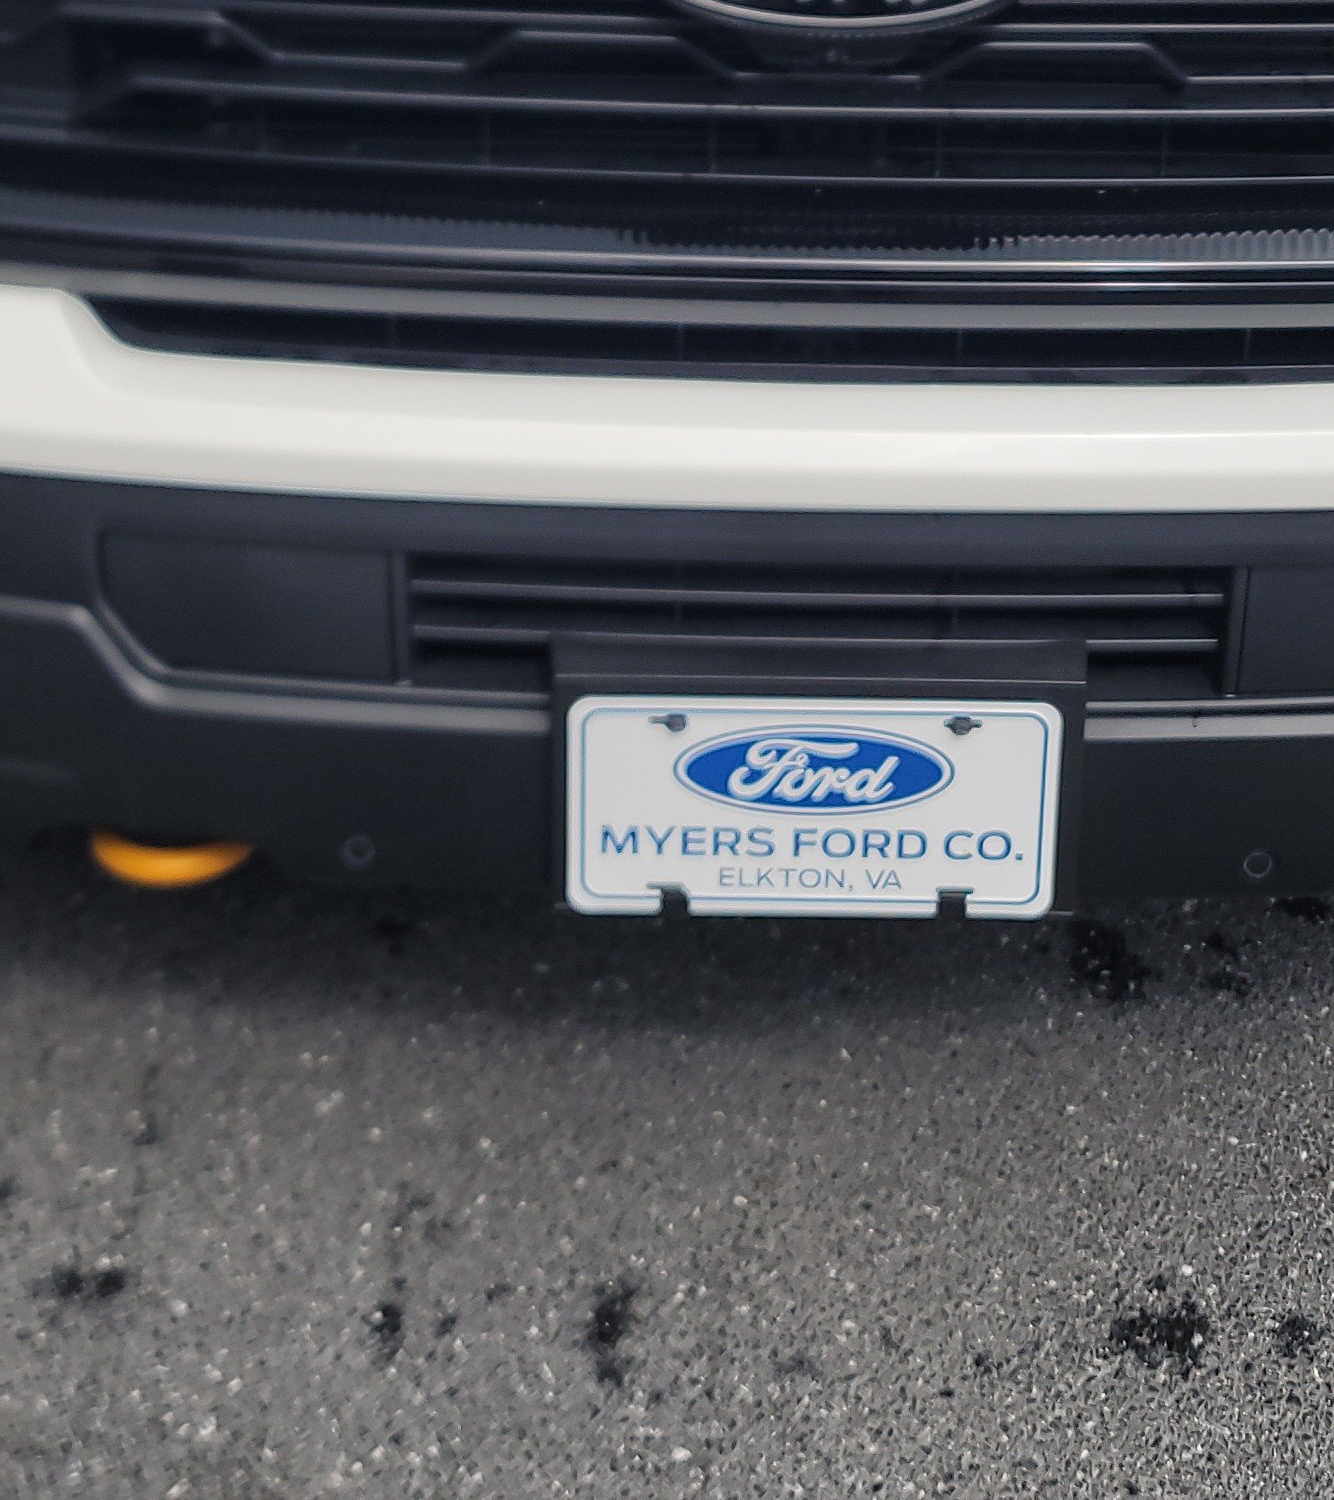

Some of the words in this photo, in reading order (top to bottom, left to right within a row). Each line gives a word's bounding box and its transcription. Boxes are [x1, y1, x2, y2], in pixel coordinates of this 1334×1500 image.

[727, 738, 899, 801] Ford
[600, 825, 775, 858] MYERS
[792, 828, 927, 860] FORD
[943, 830, 1024, 862] CO.
[719, 866, 854, 893] ELKTON,
[865, 869, 903, 891] VA
